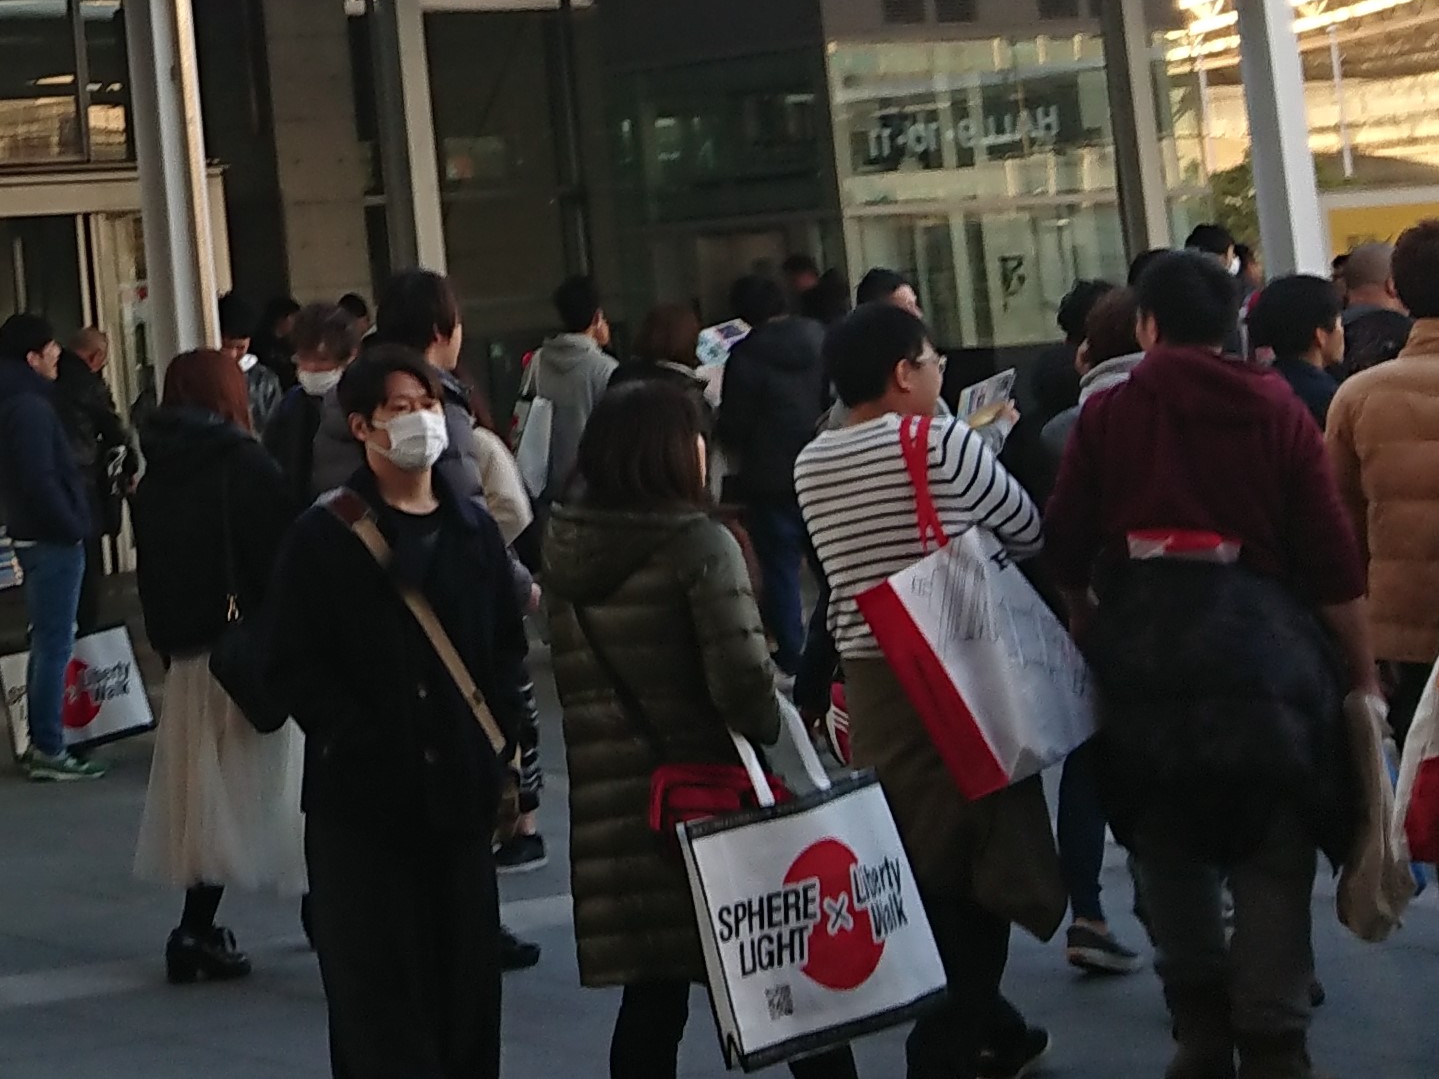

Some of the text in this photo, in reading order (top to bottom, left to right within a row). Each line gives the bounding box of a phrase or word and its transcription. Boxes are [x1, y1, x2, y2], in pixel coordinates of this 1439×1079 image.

[853, 856, 903, 905] Liberty
[718, 881, 819, 942] SPHERE
[870, 891, 908, 941] Walk
[738, 926, 809, 978] LIGHT
